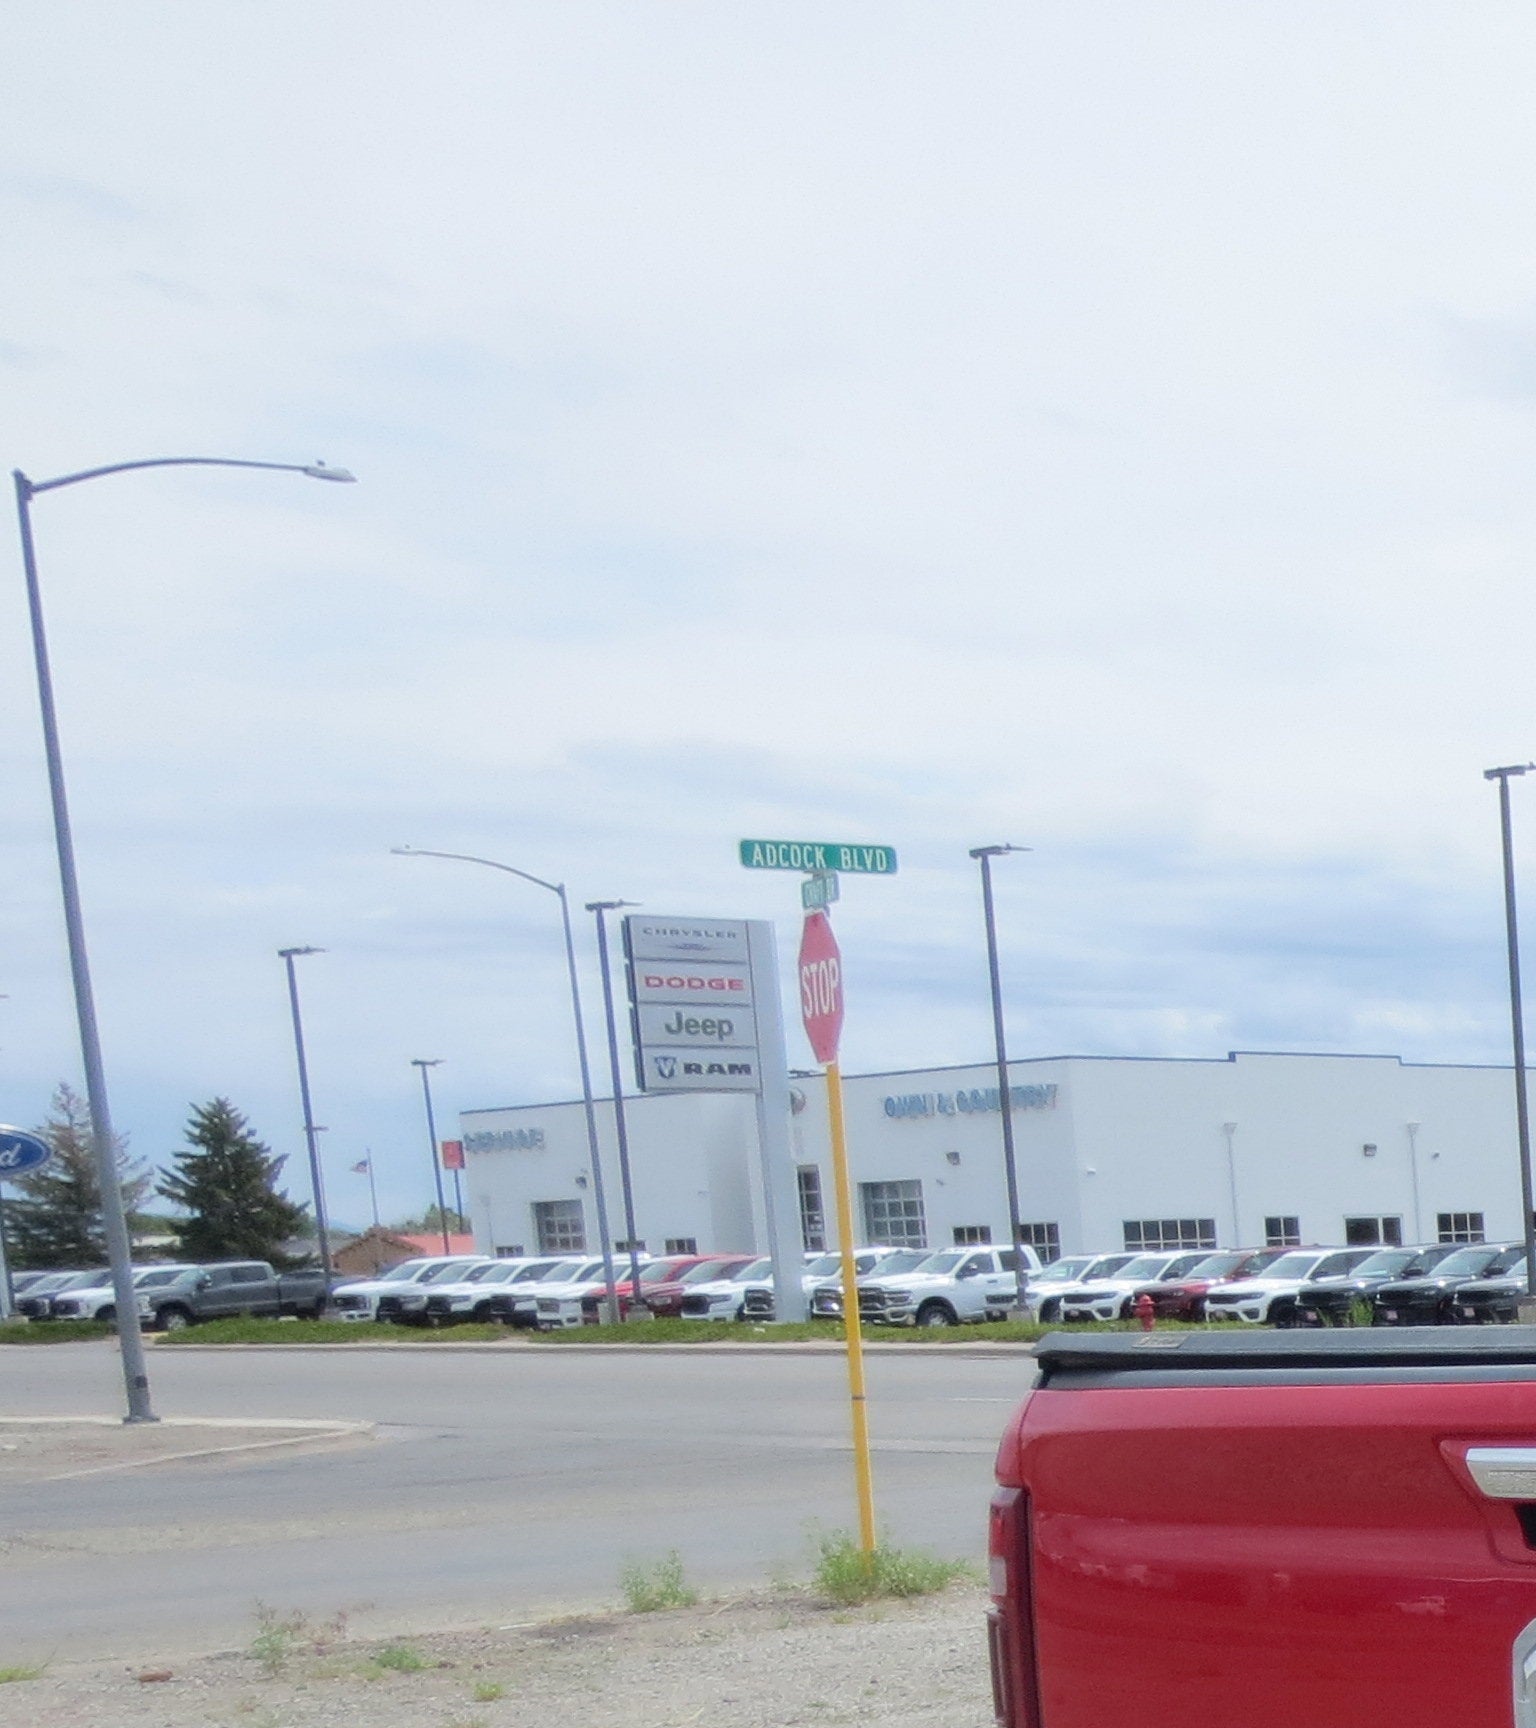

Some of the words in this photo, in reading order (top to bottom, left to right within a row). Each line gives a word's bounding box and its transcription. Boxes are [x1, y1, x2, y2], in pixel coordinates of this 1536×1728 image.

[752, 842, 828, 869] ADCOCK
[839, 846, 888, 872] BLVD
[642, 927, 738, 939] CHRYSLER
[643, 975, 745, 992] DODGE
[801, 957, 839, 1019] STOP
[664, 1011, 735, 1042] Jeep
[683, 1062, 753, 1076] RAM
